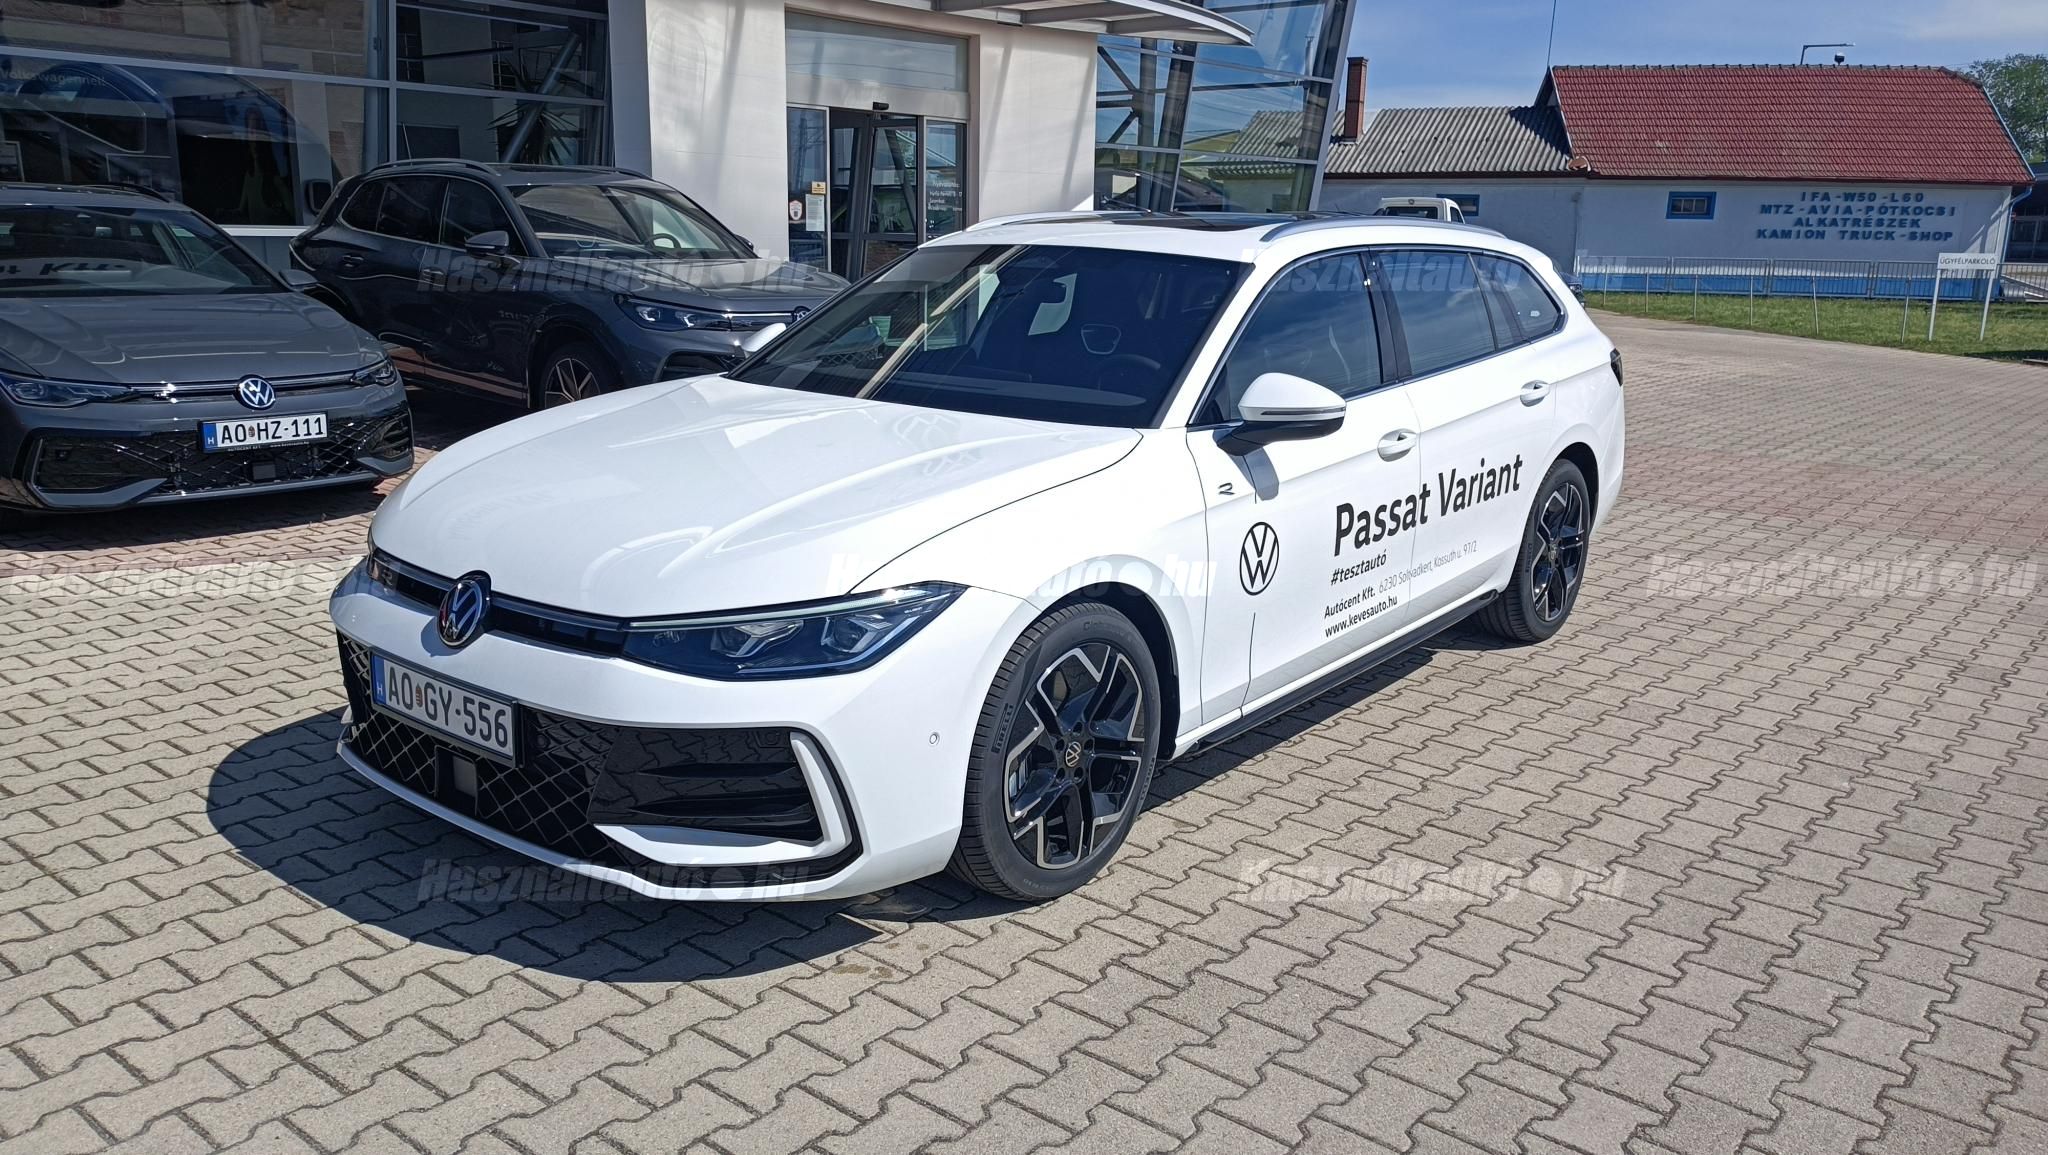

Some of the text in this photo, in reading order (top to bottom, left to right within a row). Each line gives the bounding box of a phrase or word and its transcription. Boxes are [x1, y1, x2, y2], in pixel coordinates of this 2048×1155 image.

[1756, 229, 1827, 240] KAMION
[1794, 216, 1922, 229] ALKATRÉSZEK
[221, 423, 248, 445] AO
[257, 416, 325, 441] HZ-111
[1333, 454, 1523, 557] Passat Variant
[1330, 548, 1387, 587] #tesztautó
[1324, 591, 1361, 619] Autócent
[1362, 586, 1376, 604] Kft.
[1378, 574, 1398, 594] 6230
[1325, 595, 1398, 638] www.kevesauto.hu
[388, 666, 414, 712] AO
[423, 682, 509, 749] GY-556
